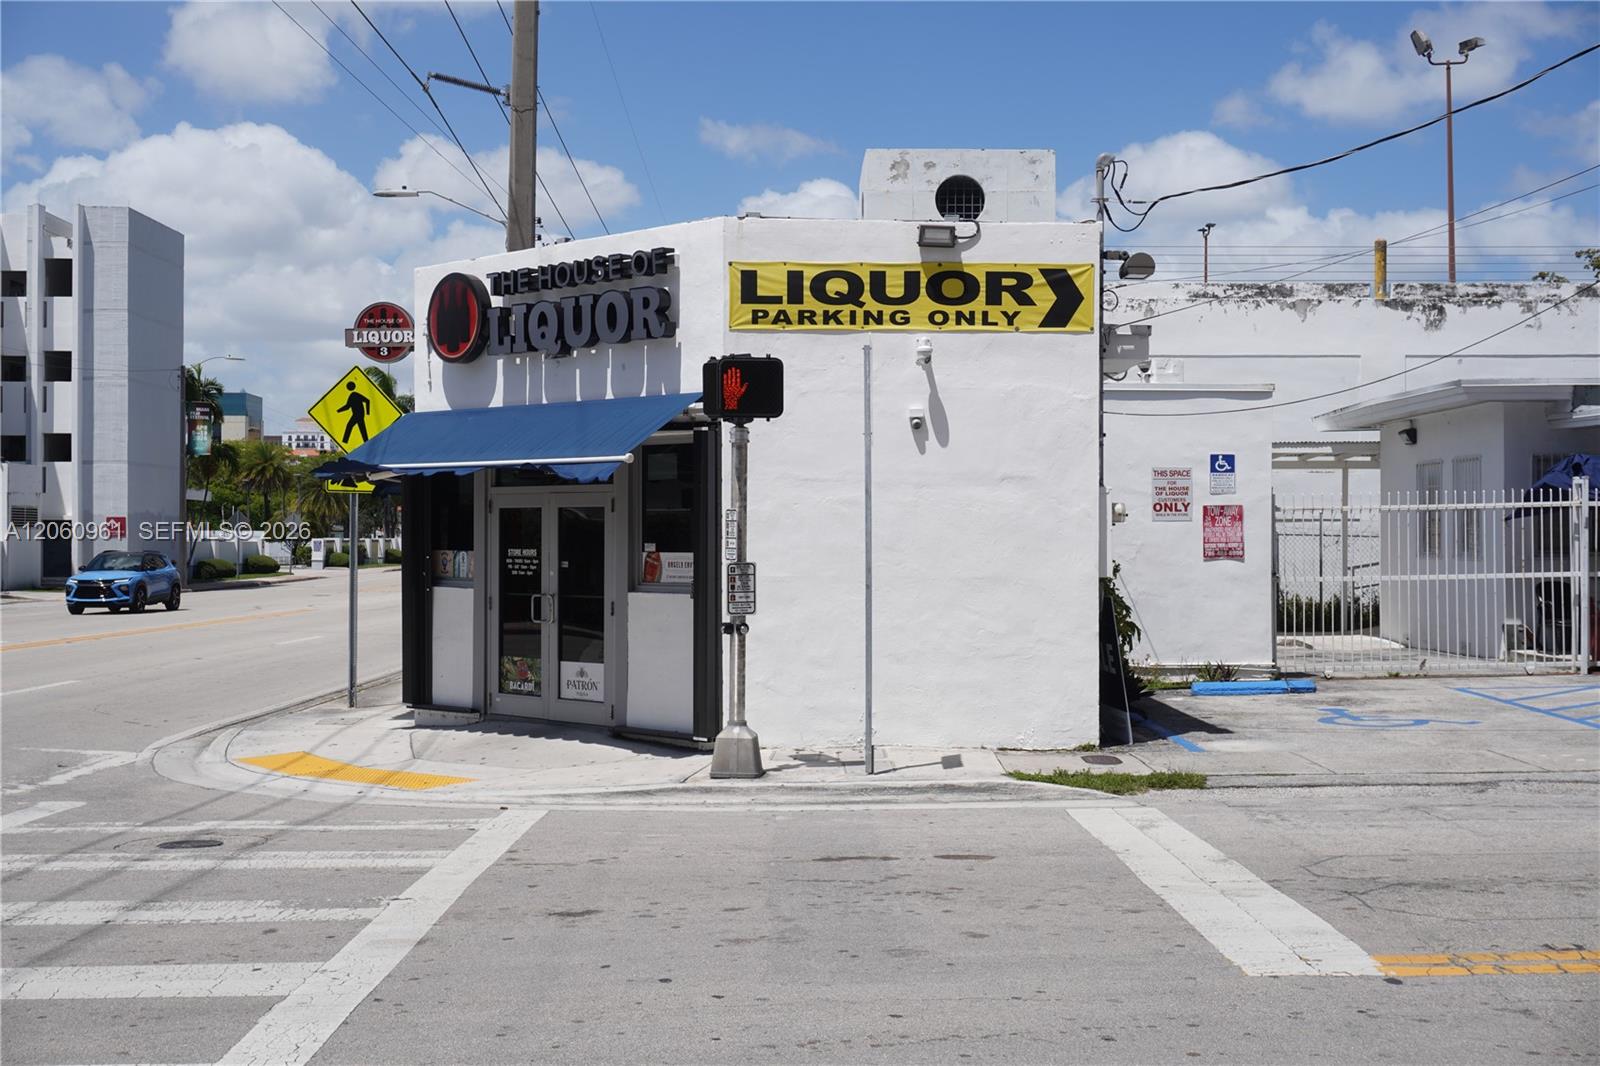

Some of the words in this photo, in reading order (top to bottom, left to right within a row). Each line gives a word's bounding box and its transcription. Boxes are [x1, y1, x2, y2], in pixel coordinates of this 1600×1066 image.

[486, 268, 532, 296] THE
[538, 253, 632, 289] HOUSE
[631, 247, 675, 276] OF
[740, 269, 1037, 308] LIQUOR
[487, 286, 676, 358] LIQUOR
[751, 309, 911, 326] PARKING
[928, 310, 1021, 327] ONLY
[353, 330, 415, 344] LIQUOR
[380, 347, 388, 356] 3
[1153, 503, 1190, 512] ONLY
[566, 678, 598, 691] PATRÓN
